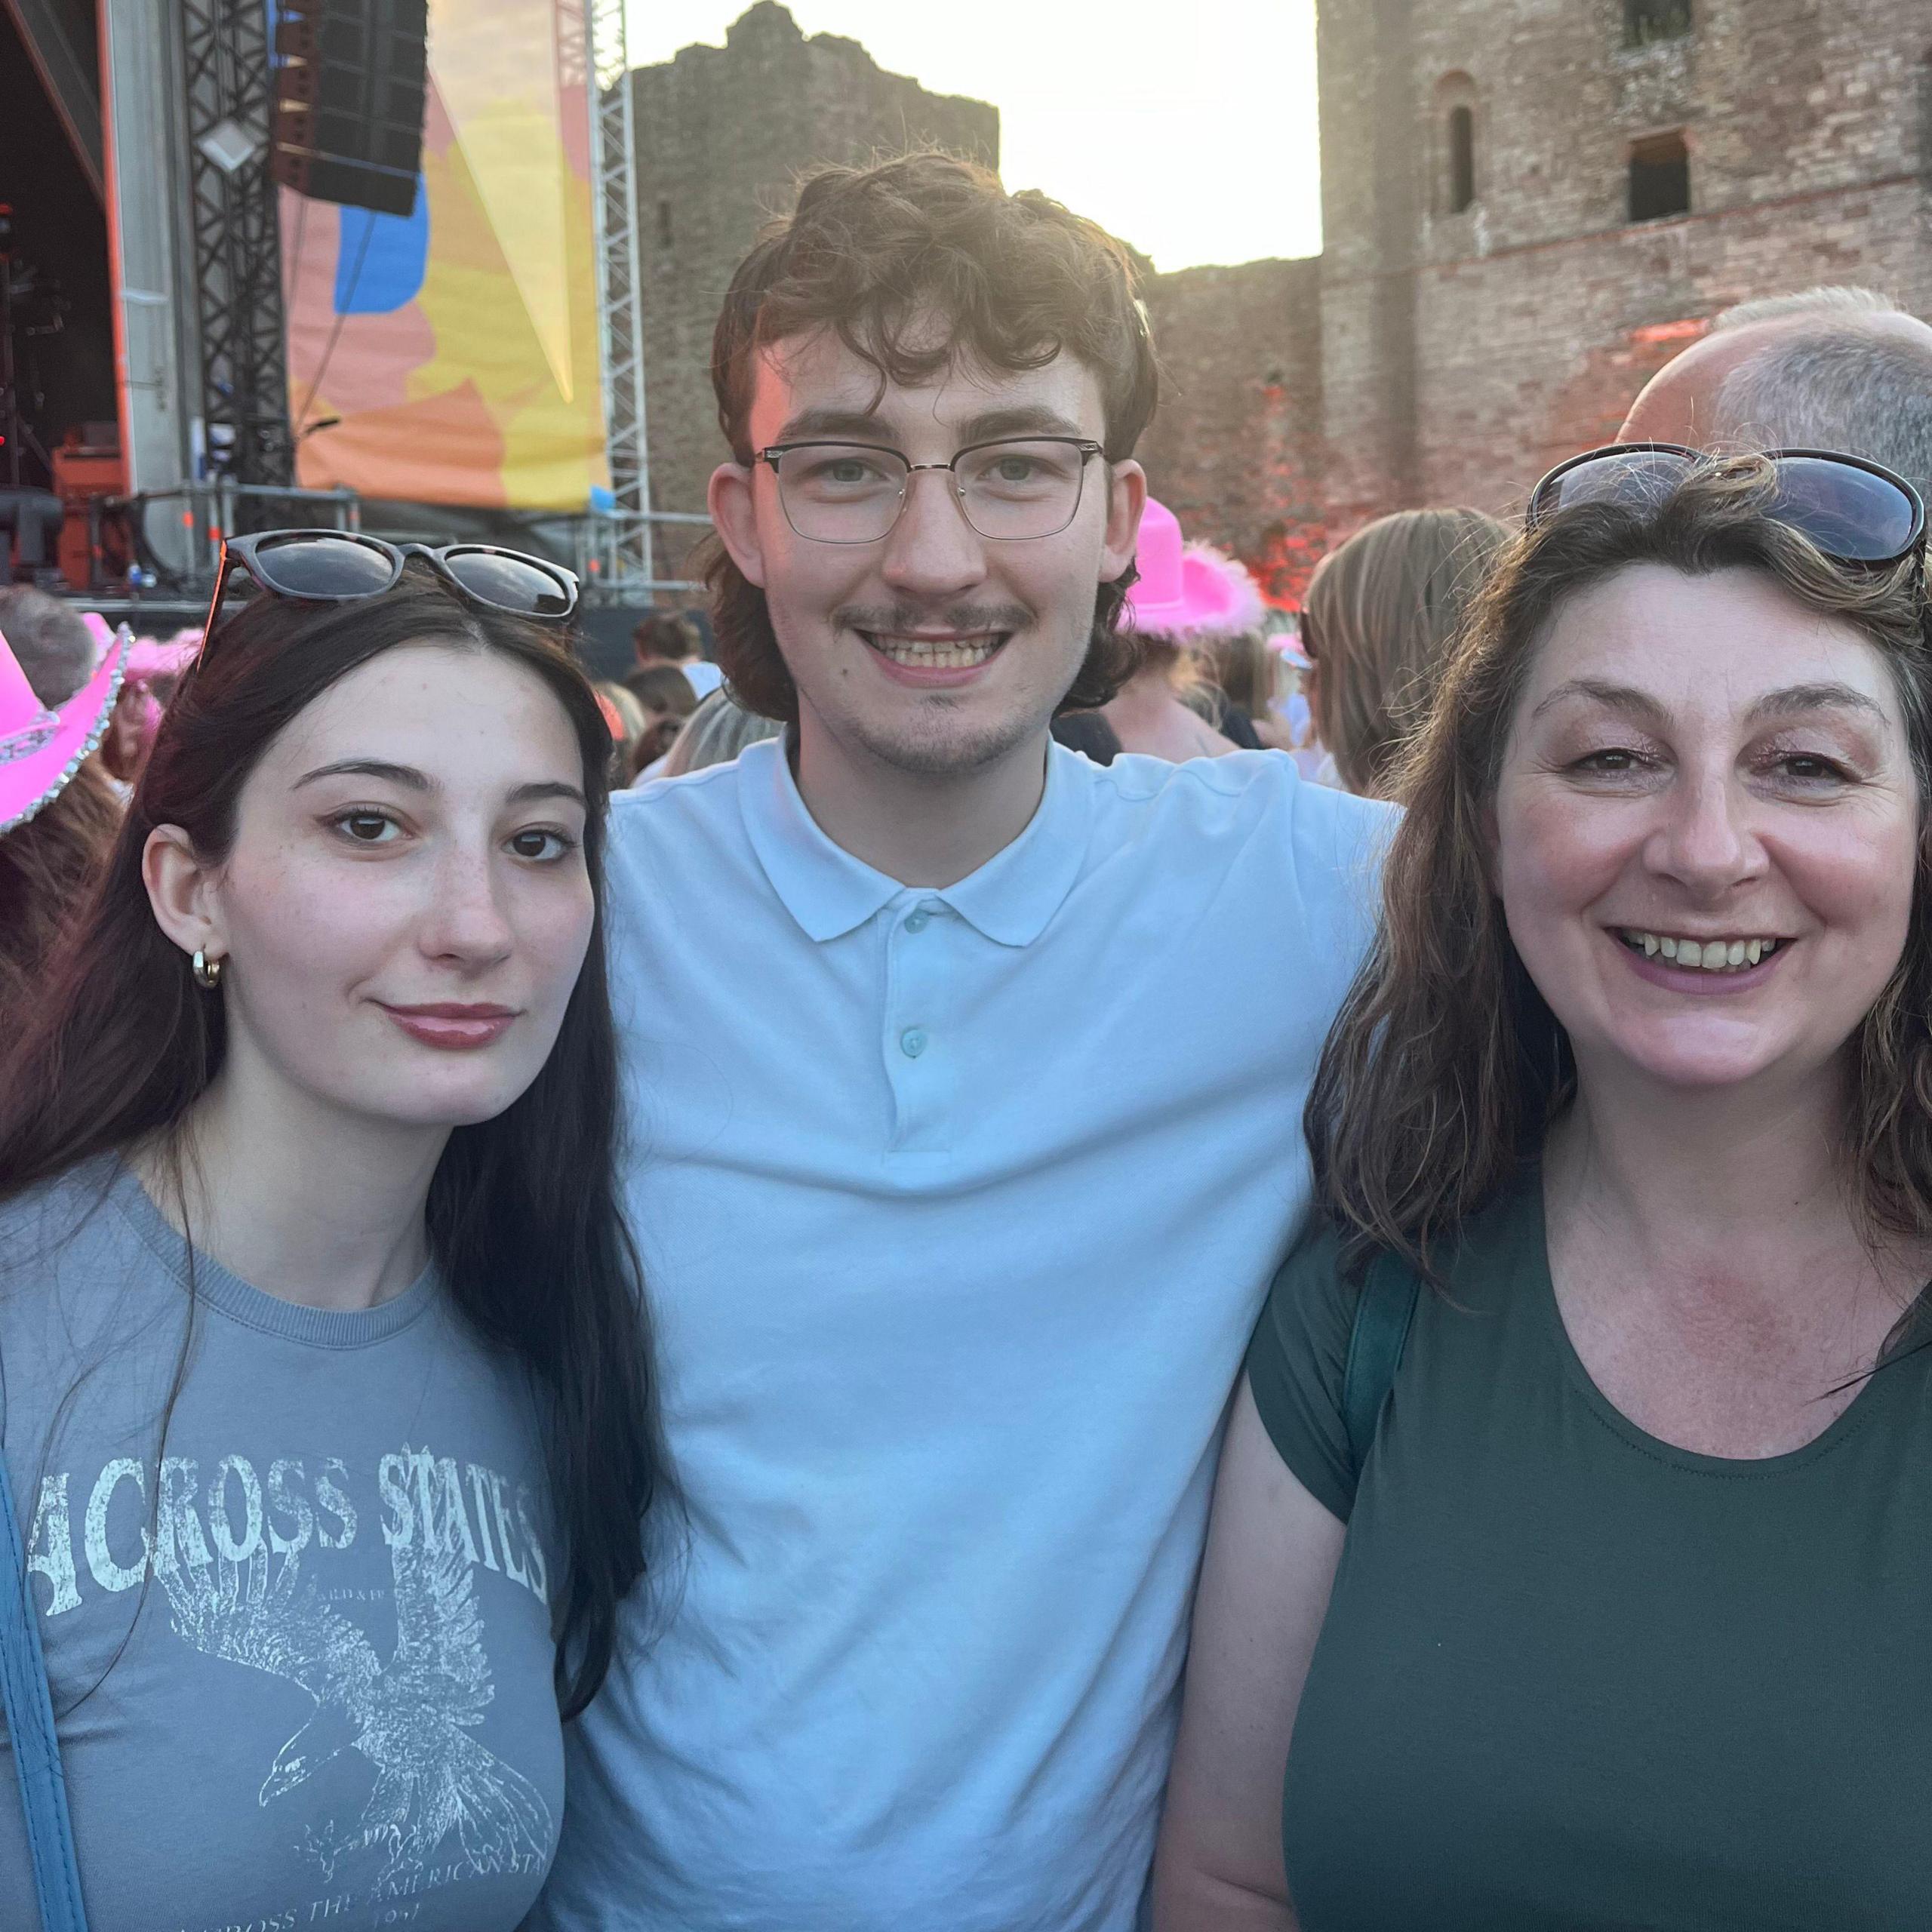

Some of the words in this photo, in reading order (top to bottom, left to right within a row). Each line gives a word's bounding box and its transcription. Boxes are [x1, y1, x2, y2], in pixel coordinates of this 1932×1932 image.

[27, 1454, 358, 1617] ACROSS
[378, 1452, 547, 1605] STATES
[310, 1893, 350, 1921] THE
